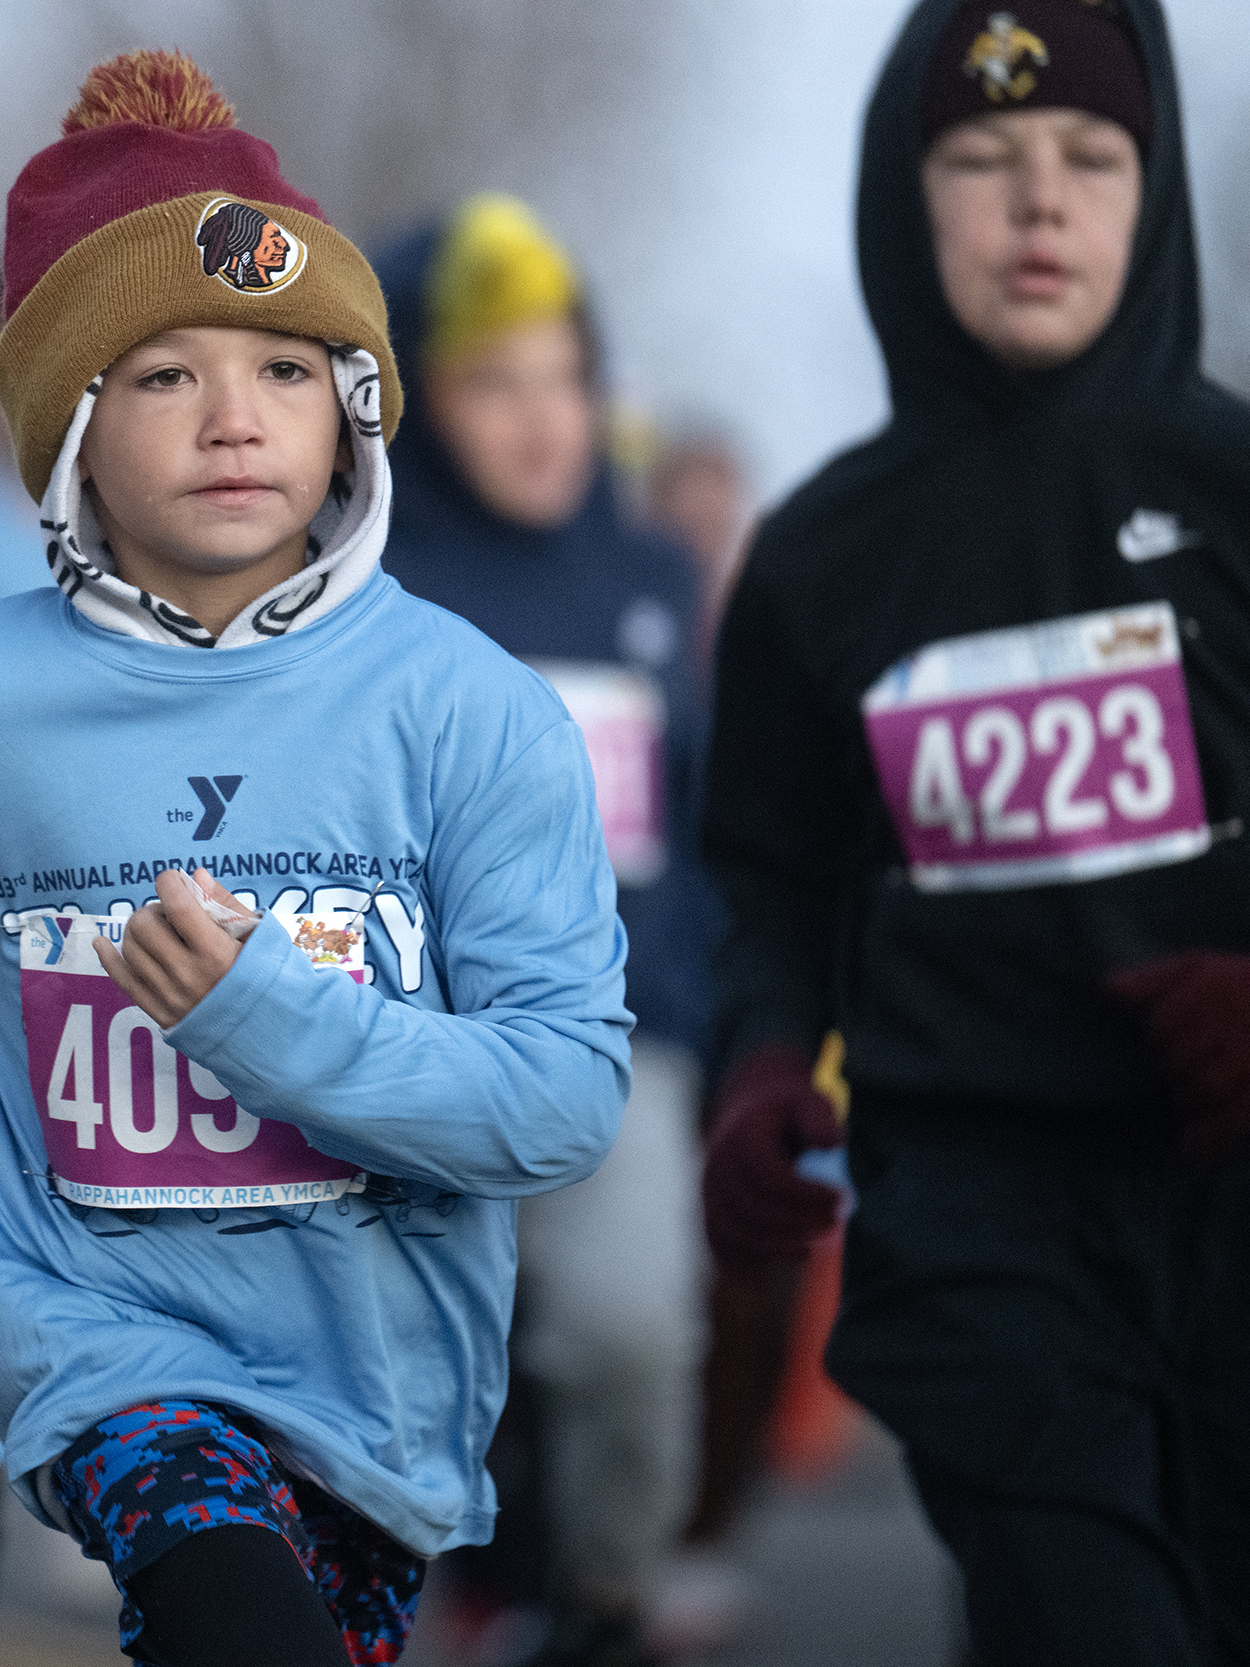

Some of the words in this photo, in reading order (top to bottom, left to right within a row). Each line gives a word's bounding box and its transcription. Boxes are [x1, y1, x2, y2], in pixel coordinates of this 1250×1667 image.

[909, 684, 1174, 846] 4223
[166, 808, 194, 823] the
[215, 820, 228, 838] YMCA
[32, 865, 115, 894] ANNUAL
[119, 852, 322, 886] RAPPAHANNOCK
[327, 852, 383, 880] AREA
[31, 937, 46, 948] the
[48, 1003, 262, 1154] 409
[68, 1183, 214, 1205] RAPPAHANNOCK
[221, 1187, 274, 1205] AREA
[280, 1182, 335, 1201] YMCA
